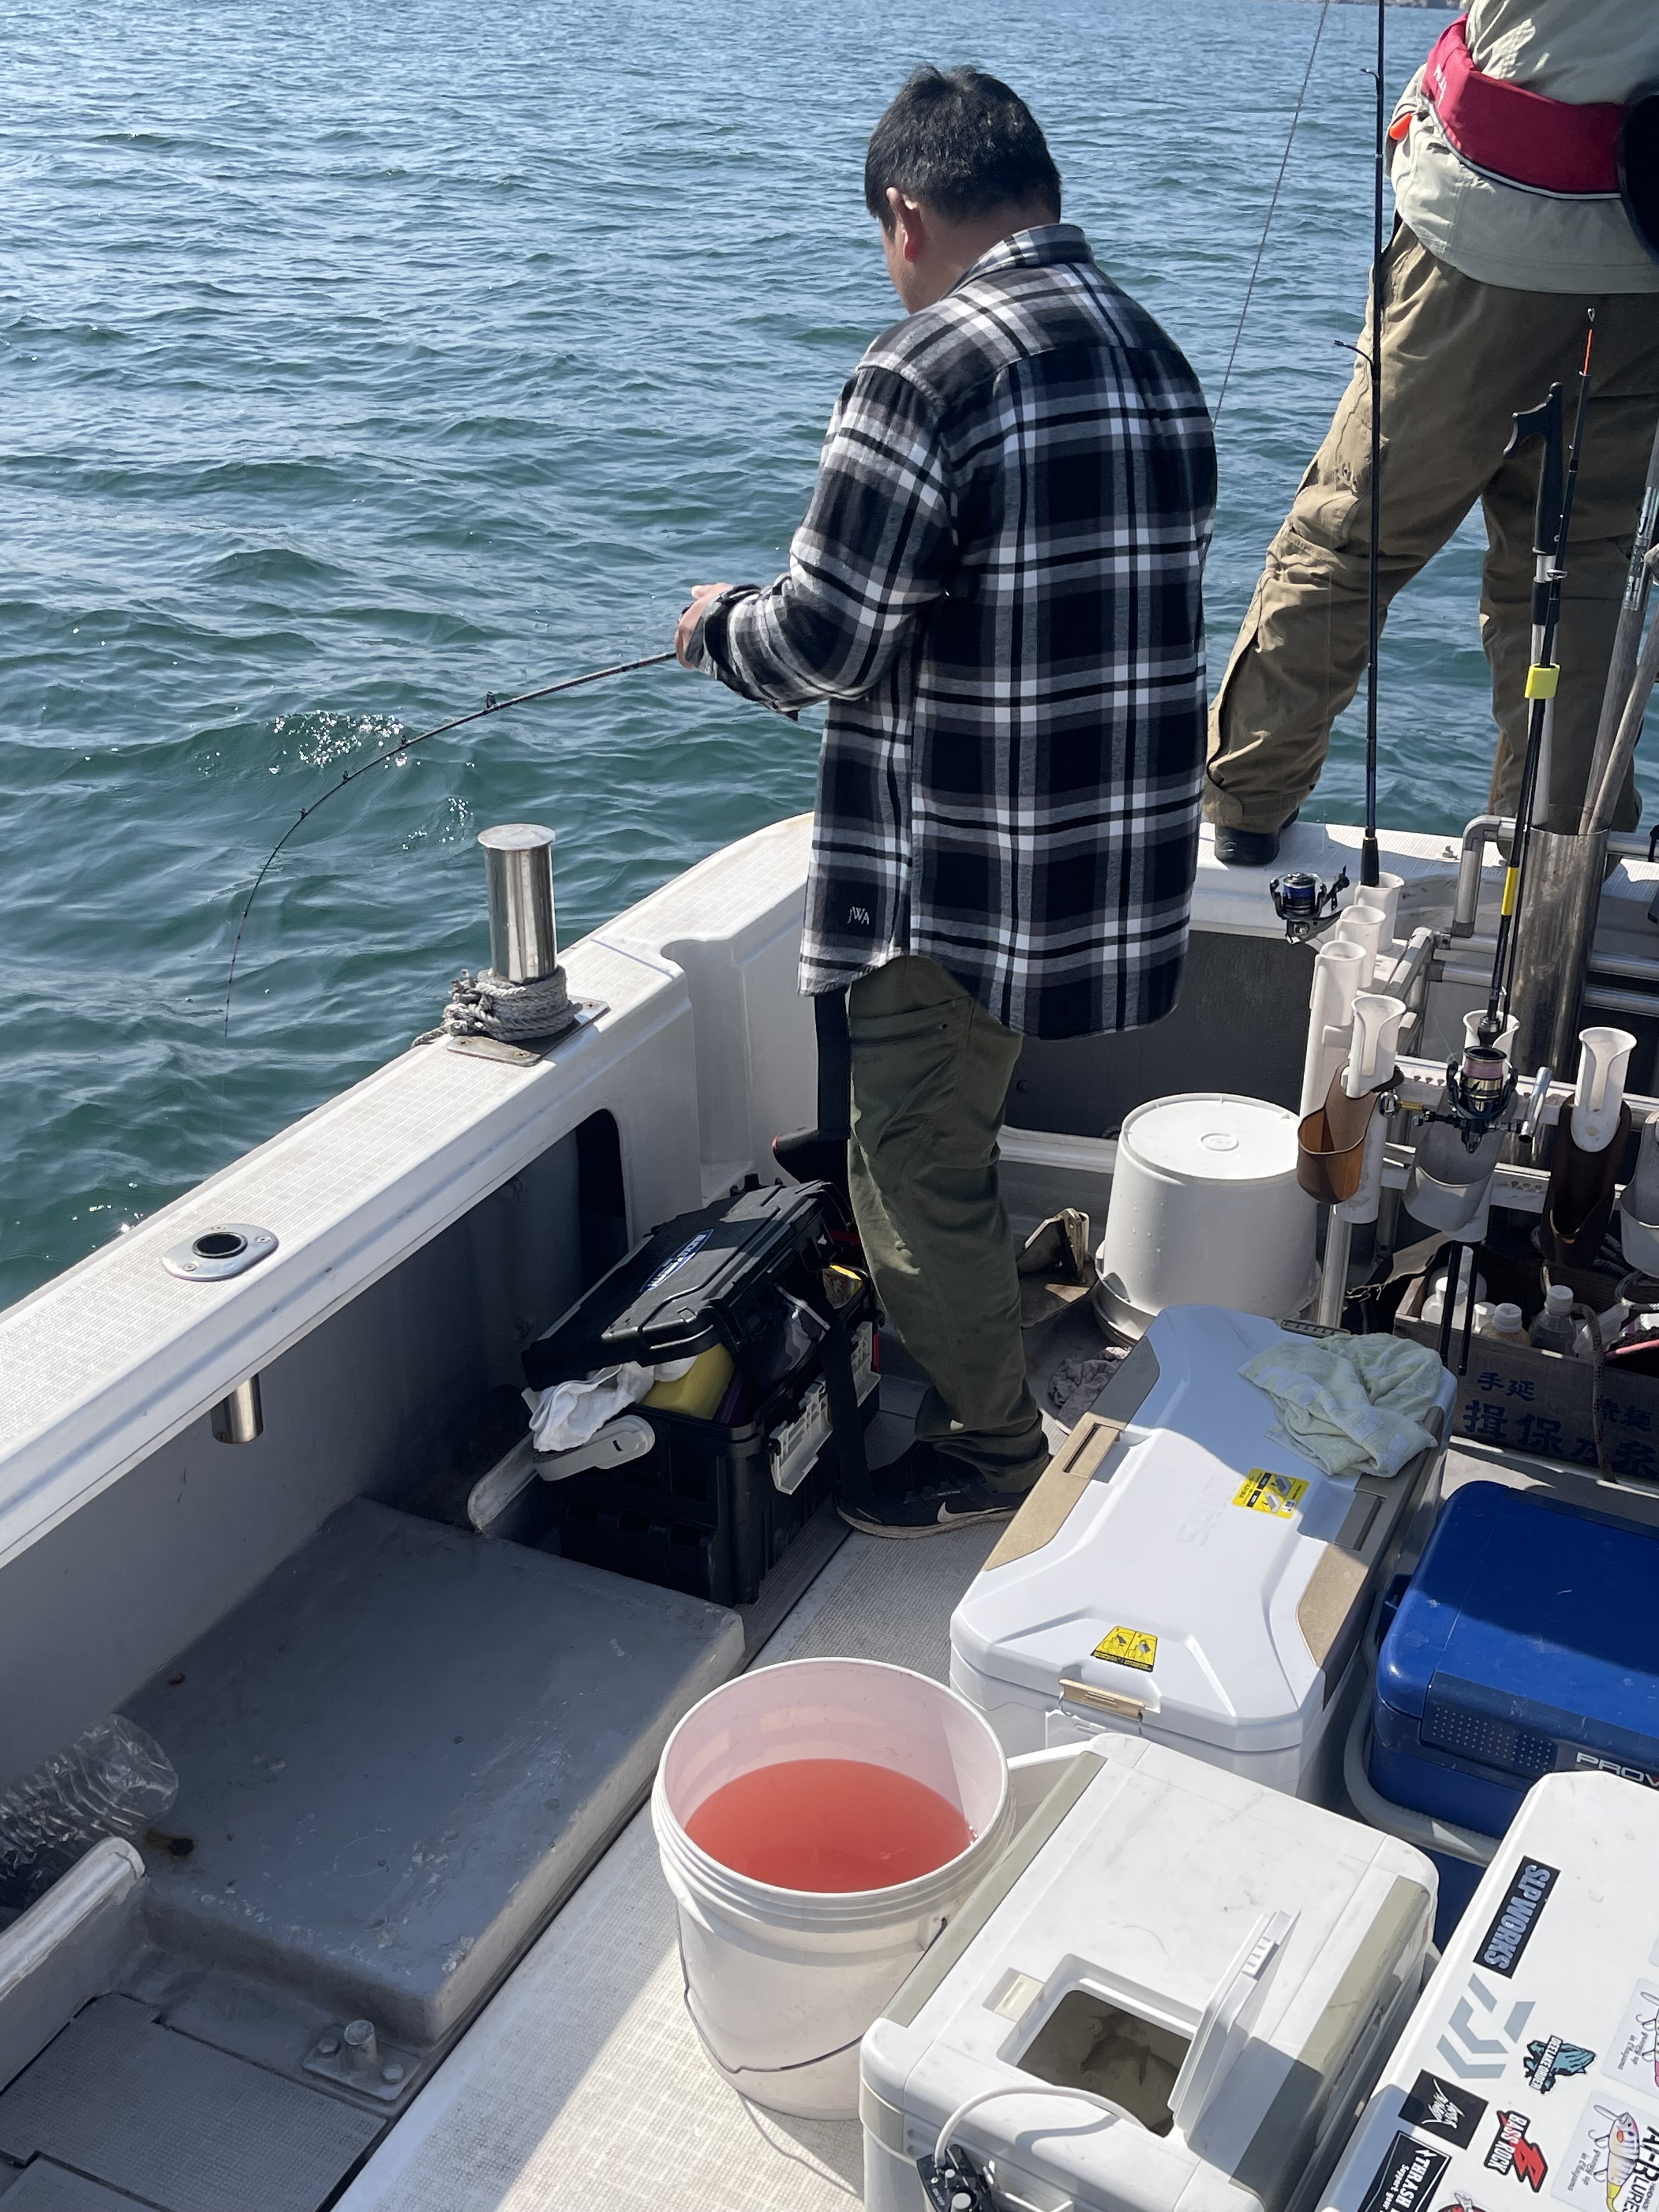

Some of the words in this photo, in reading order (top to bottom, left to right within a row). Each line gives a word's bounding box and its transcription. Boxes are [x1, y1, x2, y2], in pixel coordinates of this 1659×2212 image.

[1476, 1372, 1536, 1402] 手延
[1483, 1896, 1537, 1970] WORKS
[1500, 2113, 1527, 2145] BASS
[1487, 2140, 1516, 2173] ROCK
[1390, 2164, 1409, 2192] Support
[1395, 2156, 1431, 2208] THRASH
